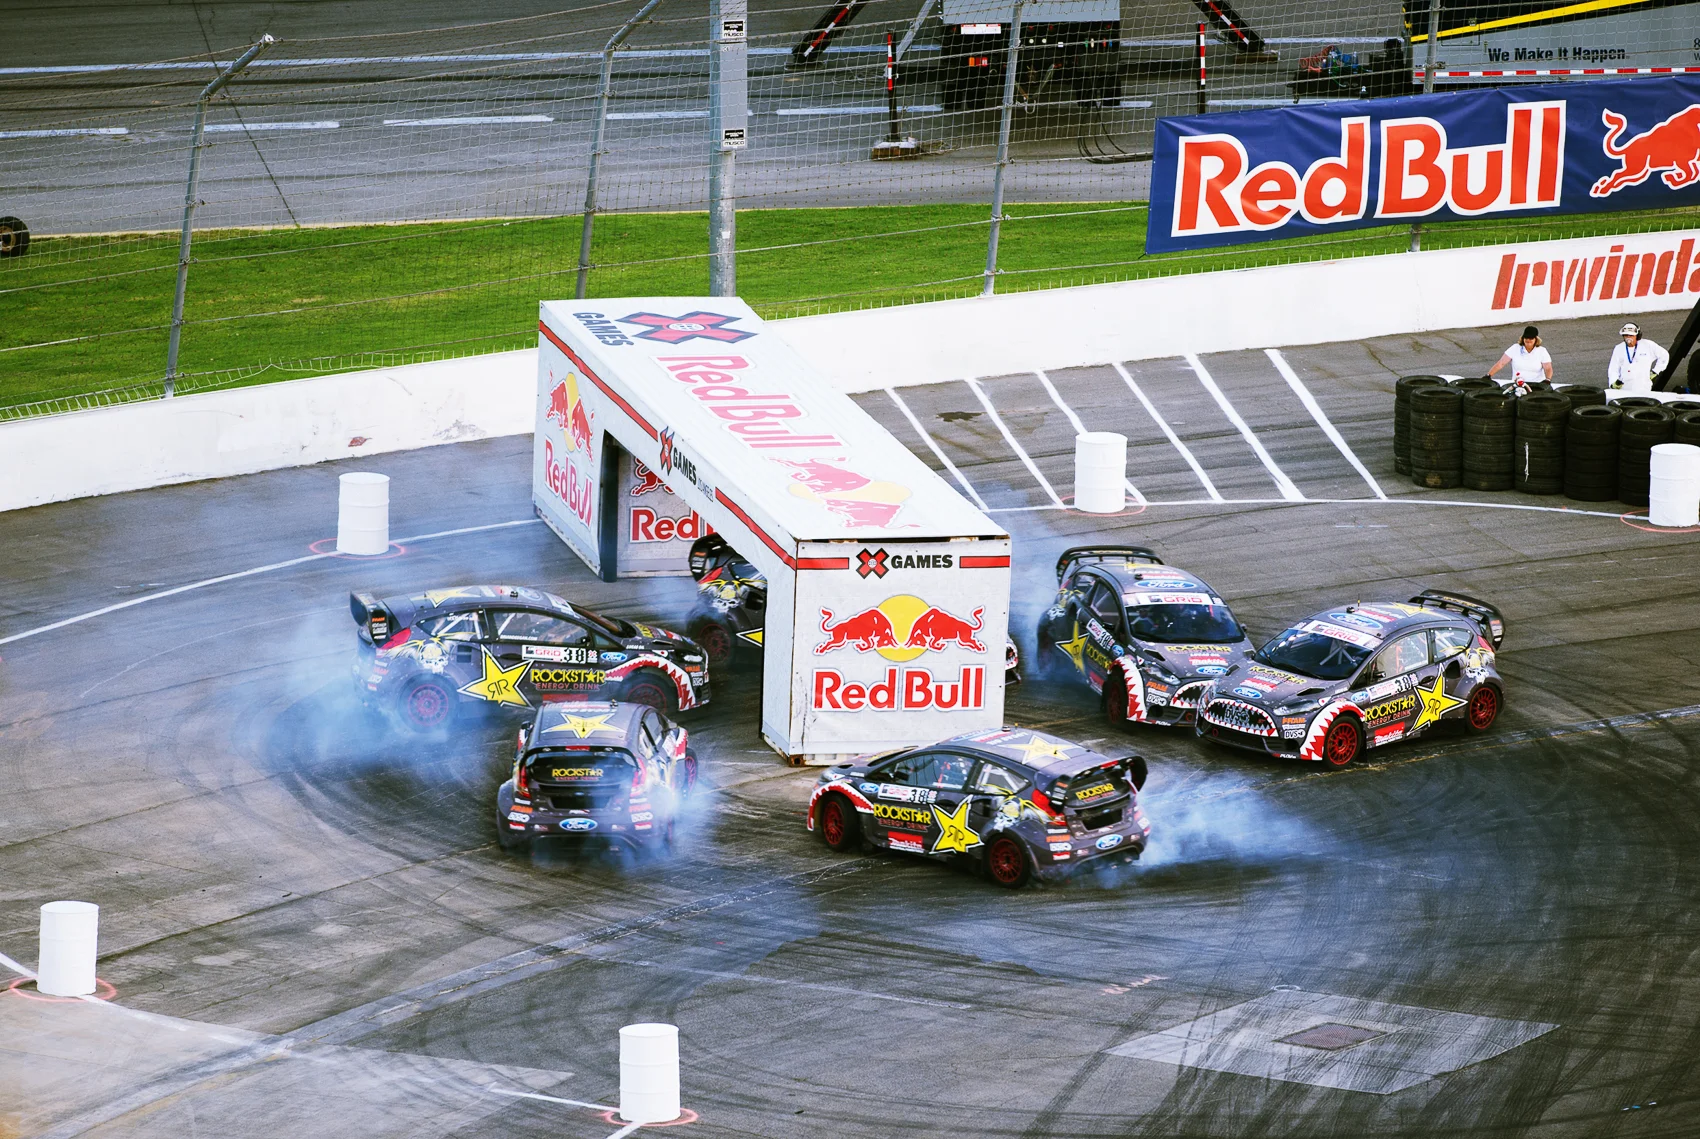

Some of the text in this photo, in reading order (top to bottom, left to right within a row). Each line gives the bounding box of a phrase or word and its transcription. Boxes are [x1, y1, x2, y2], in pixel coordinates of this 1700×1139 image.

[1487, 47, 1510, 62] We
[1514, 46, 1554, 61] Make
[1557, 46, 1568, 61] It
[1174, 101, 1566, 235] Red Bull
[572, 311, 635, 348] GAMES
[654, 354, 845, 449] Red Bull
[544, 438, 593, 528] Red Bull
[673, 446, 697, 486] GAMES
[630, 508, 700, 542] Red
[890, 554, 953, 569] GAMES
[536, 682, 600, 691] ENERGY DRINK
[813, 666, 984, 710] Red Bull
[1146, 681, 1168, 692] FRAM
[1367, 709, 1411, 728] ENERGY DRINK
